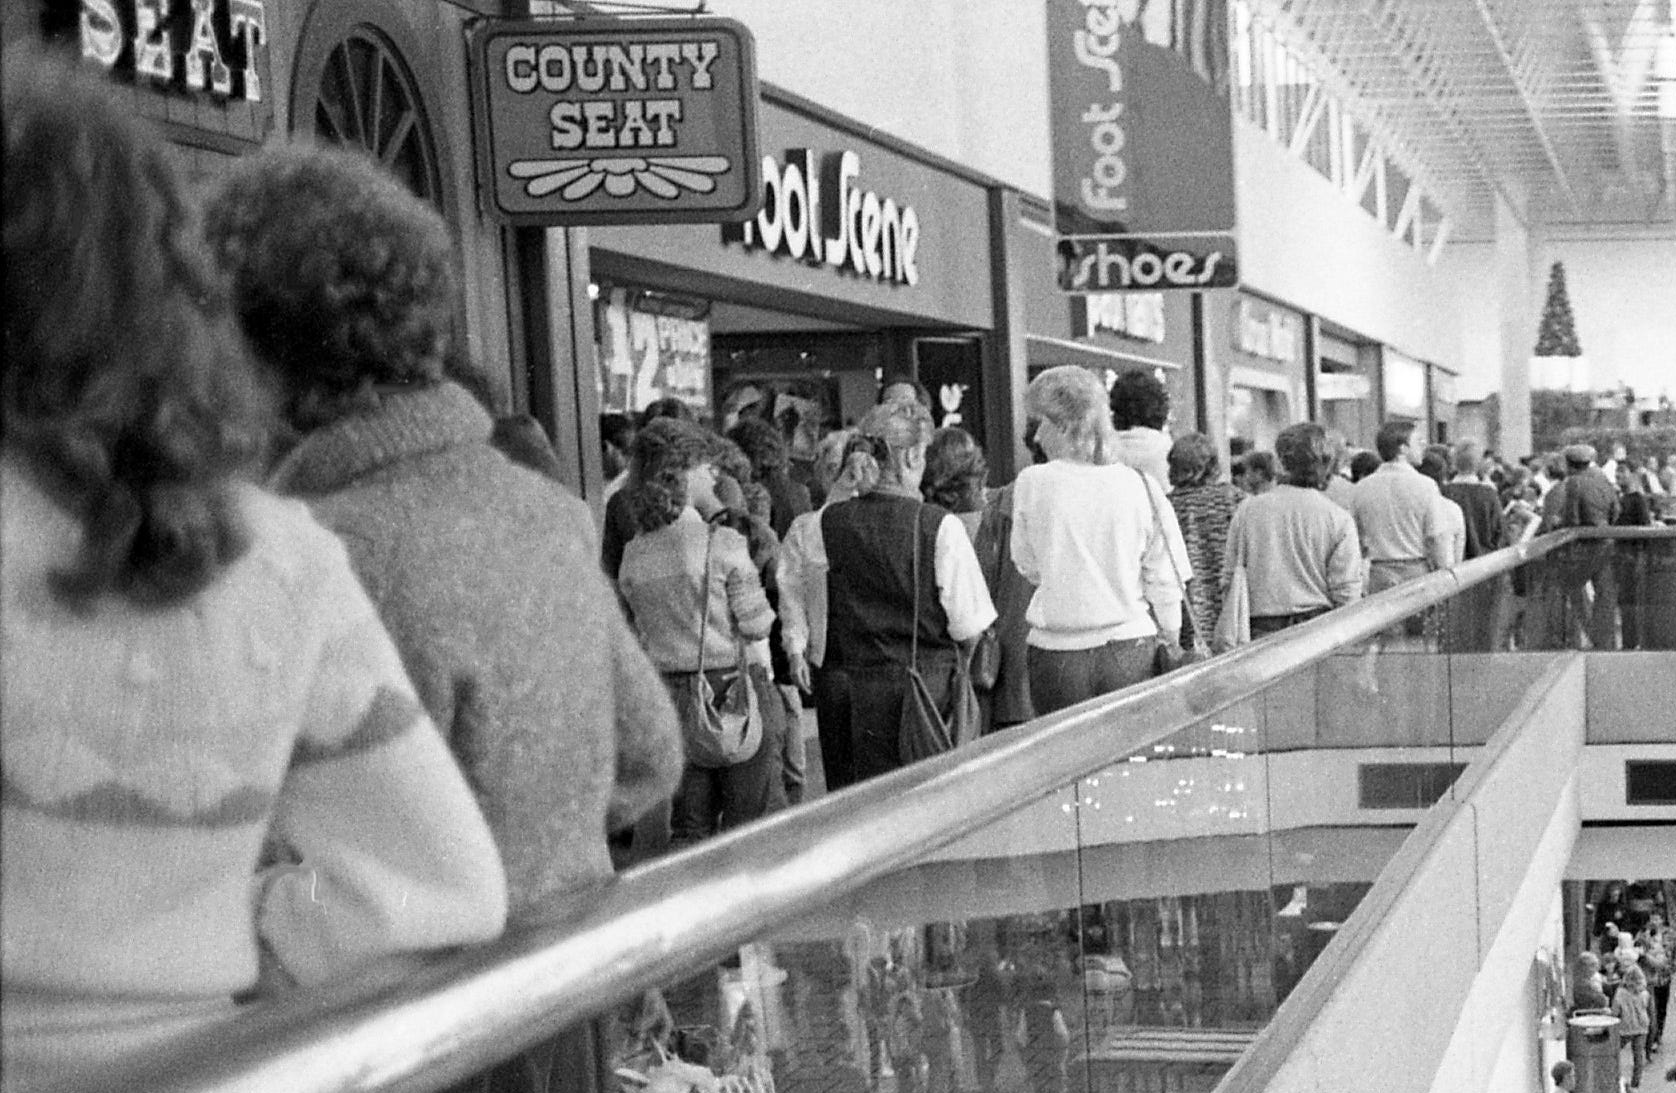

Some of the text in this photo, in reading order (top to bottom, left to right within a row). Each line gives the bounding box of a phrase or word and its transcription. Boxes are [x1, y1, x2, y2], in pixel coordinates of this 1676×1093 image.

[505, 41, 720, 93] COUNTY
[1074, 0, 1123, 92] Sce
[549, 99, 682, 150] SEAT
[743, 149, 920, 287] oot Scene
